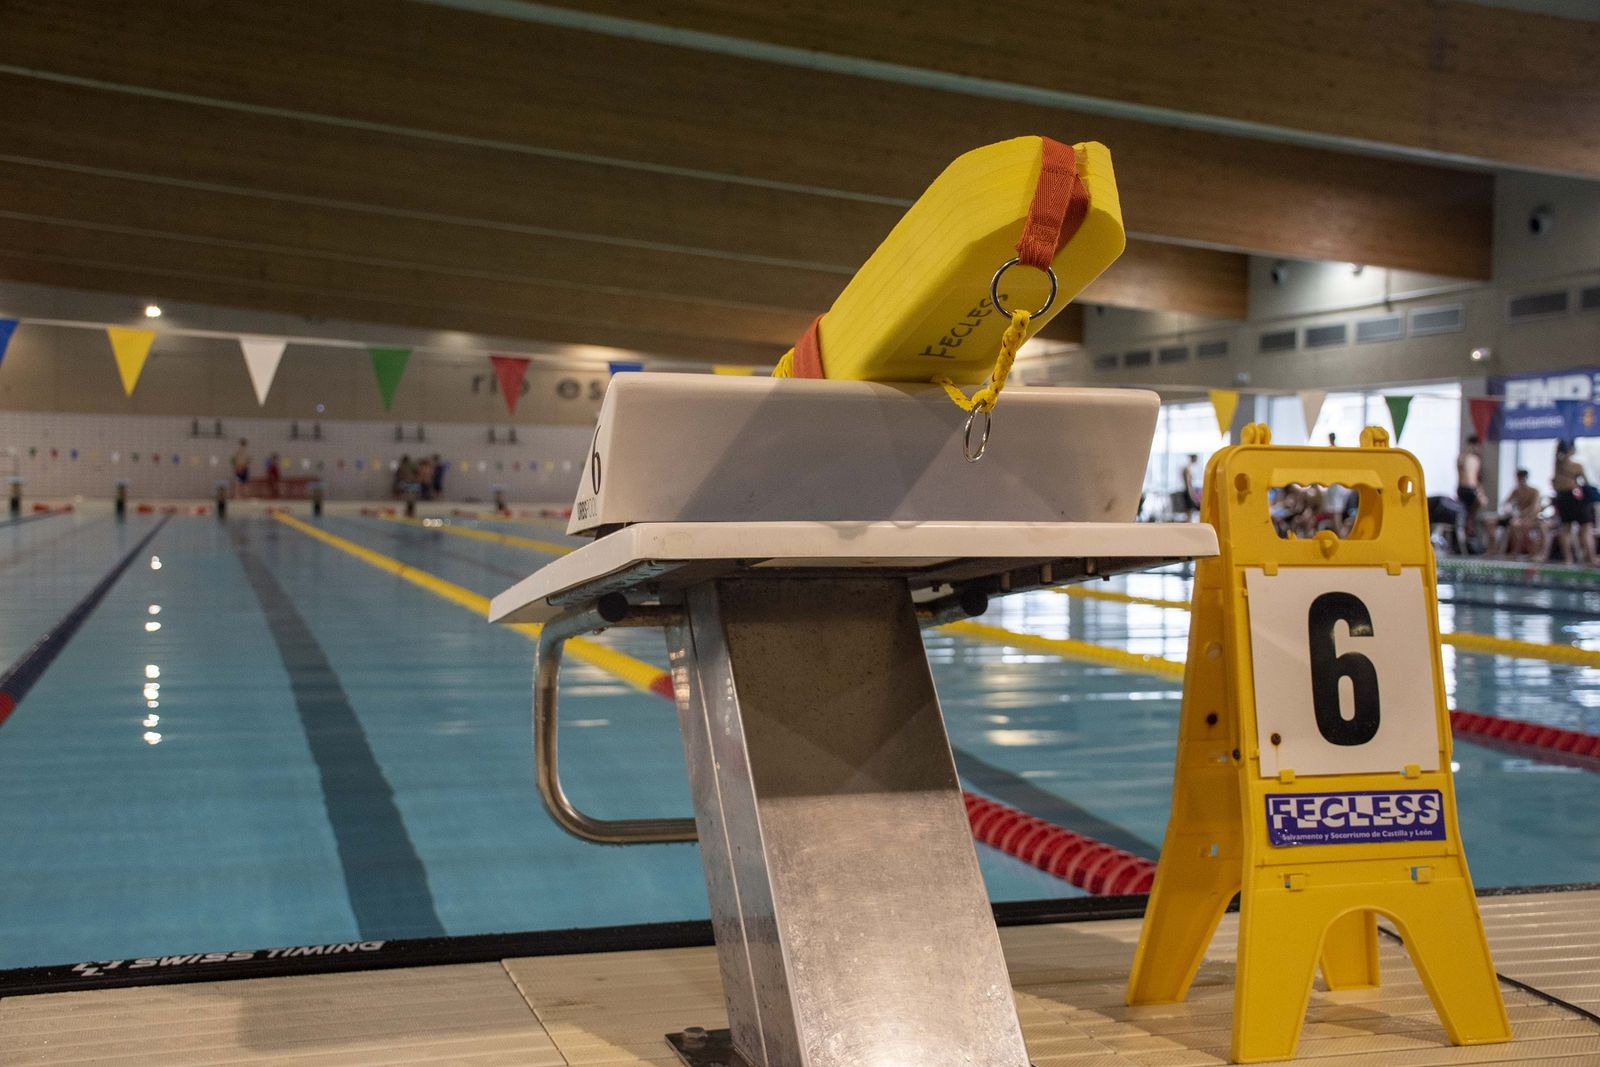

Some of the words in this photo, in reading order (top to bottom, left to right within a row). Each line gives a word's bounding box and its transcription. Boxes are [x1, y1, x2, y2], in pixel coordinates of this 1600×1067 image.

[591, 424, 602, 495] 6
[1308, 591, 1381, 746] 6
[1270, 794, 1439, 830] FECLESS
[1330, 830, 1371, 839] Socorrismo
[128, 951, 255, 969] SWISS
[266, 940, 387, 959] TIMING
